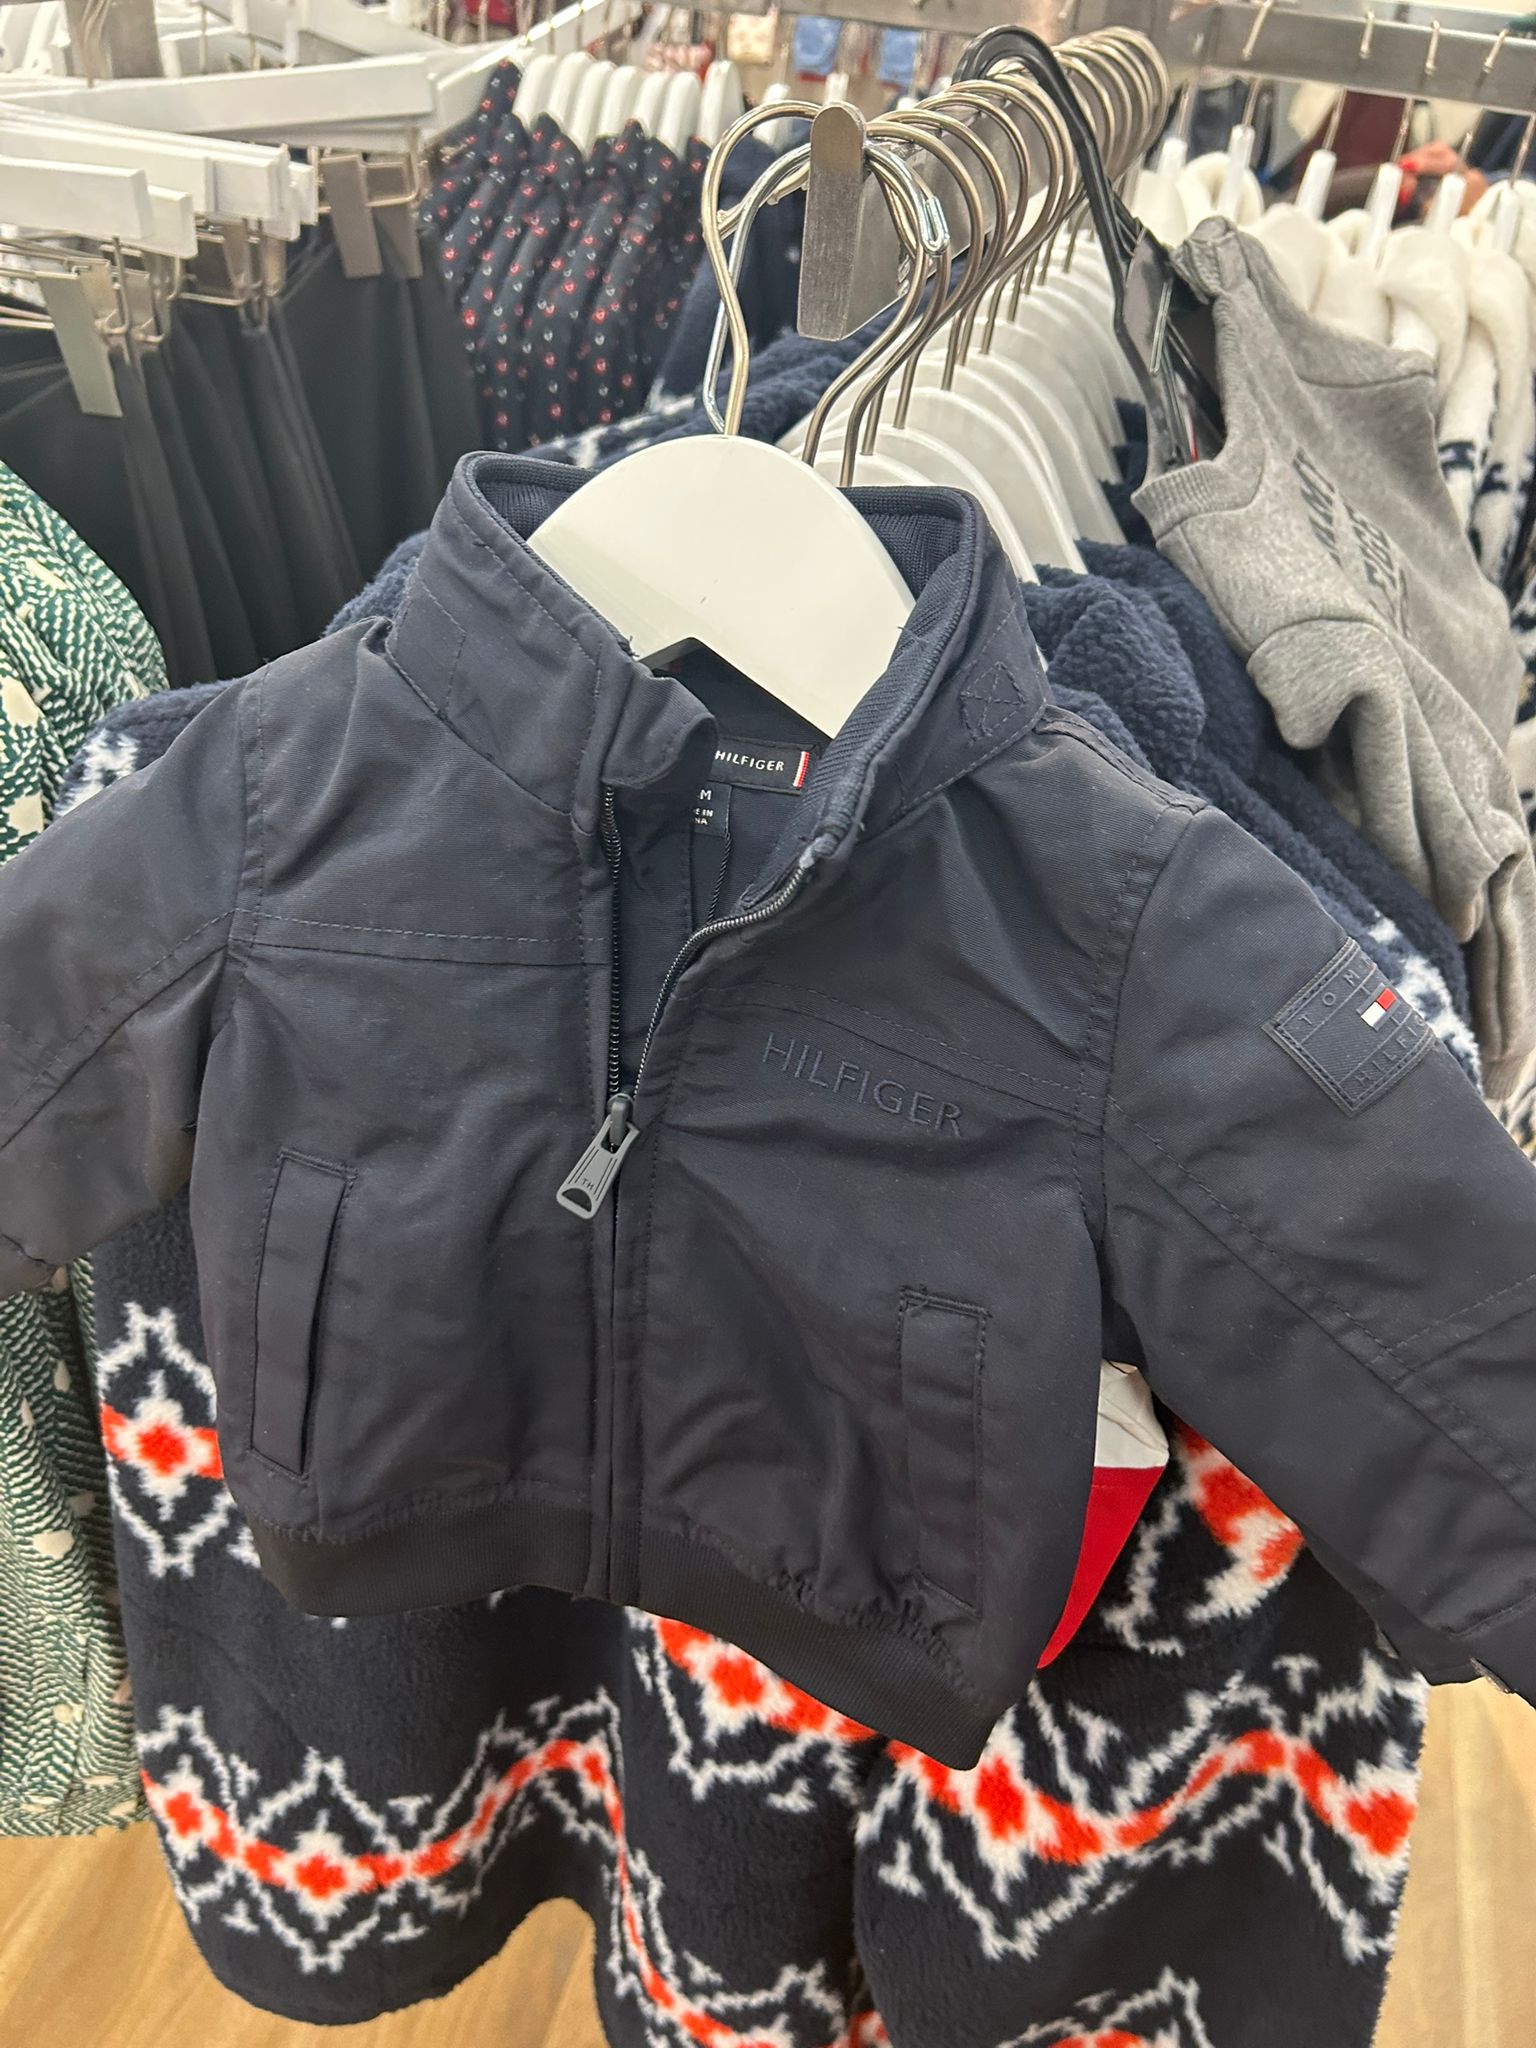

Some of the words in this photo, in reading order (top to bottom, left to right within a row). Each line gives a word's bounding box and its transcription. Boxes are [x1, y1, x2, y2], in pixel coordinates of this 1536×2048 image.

[714, 750, 785, 771] HILFIGER
[697, 789, 712, 801] M
[762, 1032, 962, 1137] HILFIGER
[582, 1178, 595, 1190] TH
